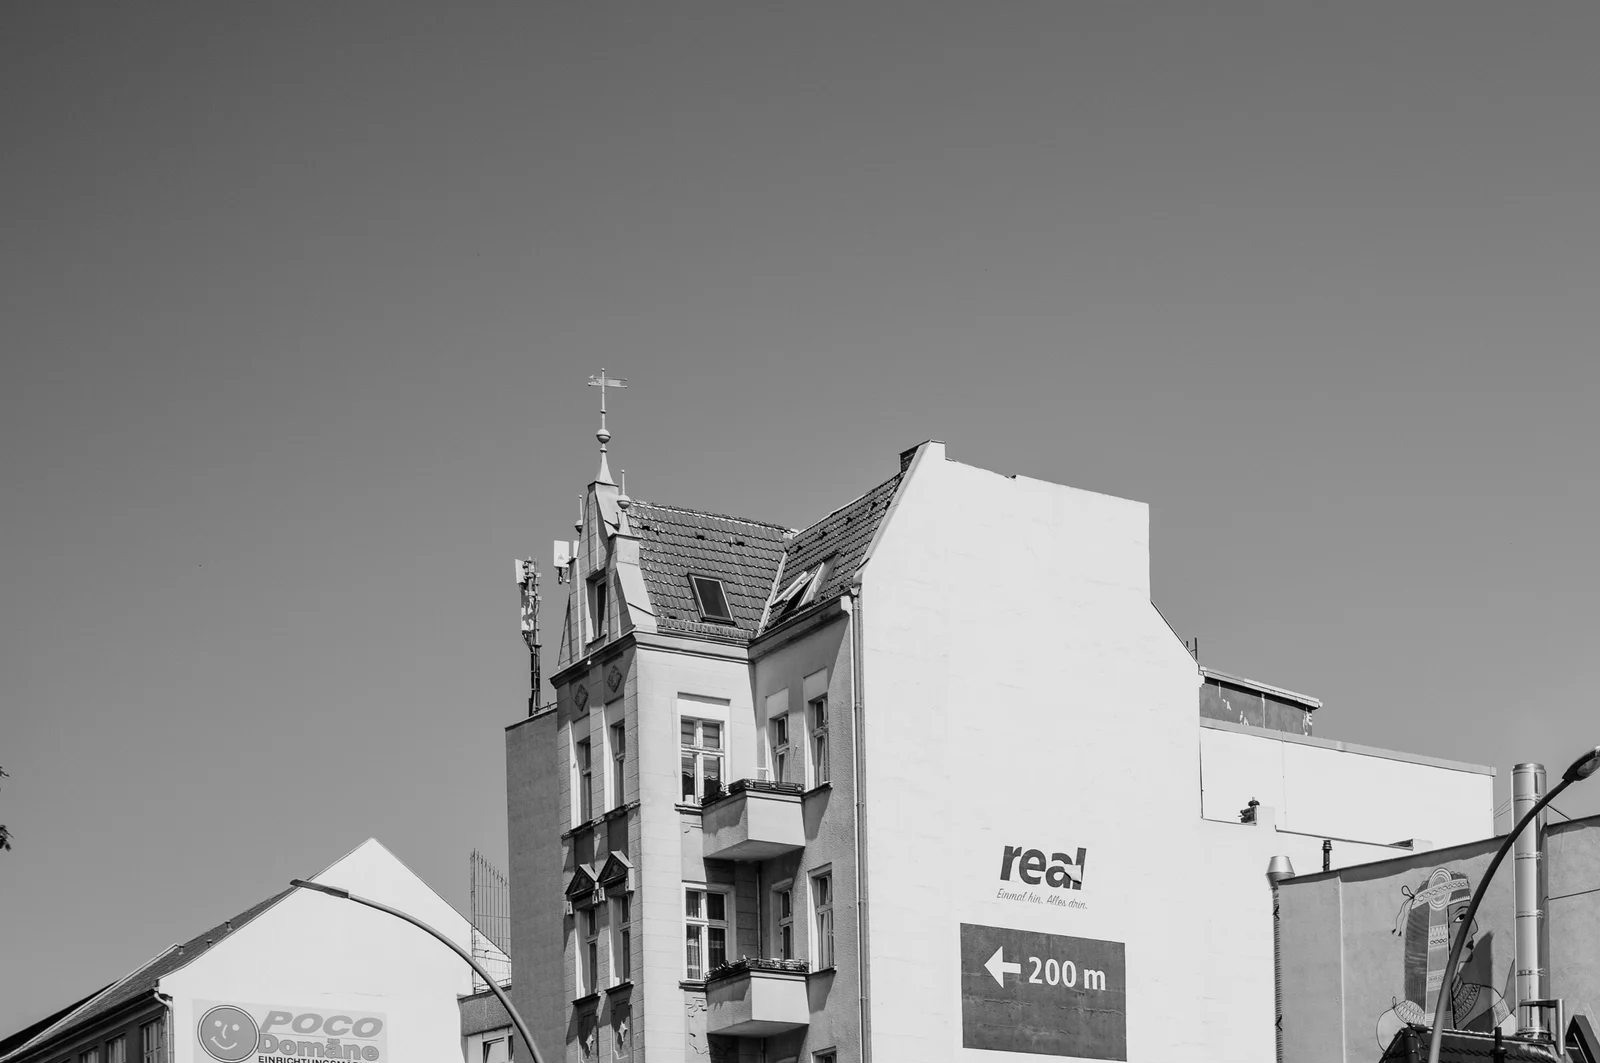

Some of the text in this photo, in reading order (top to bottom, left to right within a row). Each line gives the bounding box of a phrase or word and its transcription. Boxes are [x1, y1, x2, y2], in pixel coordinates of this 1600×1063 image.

[997, 888, 1088, 910] Einmal hin. Alles drin.
[1028, 956, 1106, 990] 200 m
[259, 1010, 384, 1038] POCO
[258, 1033, 380, 1061] Domäne
